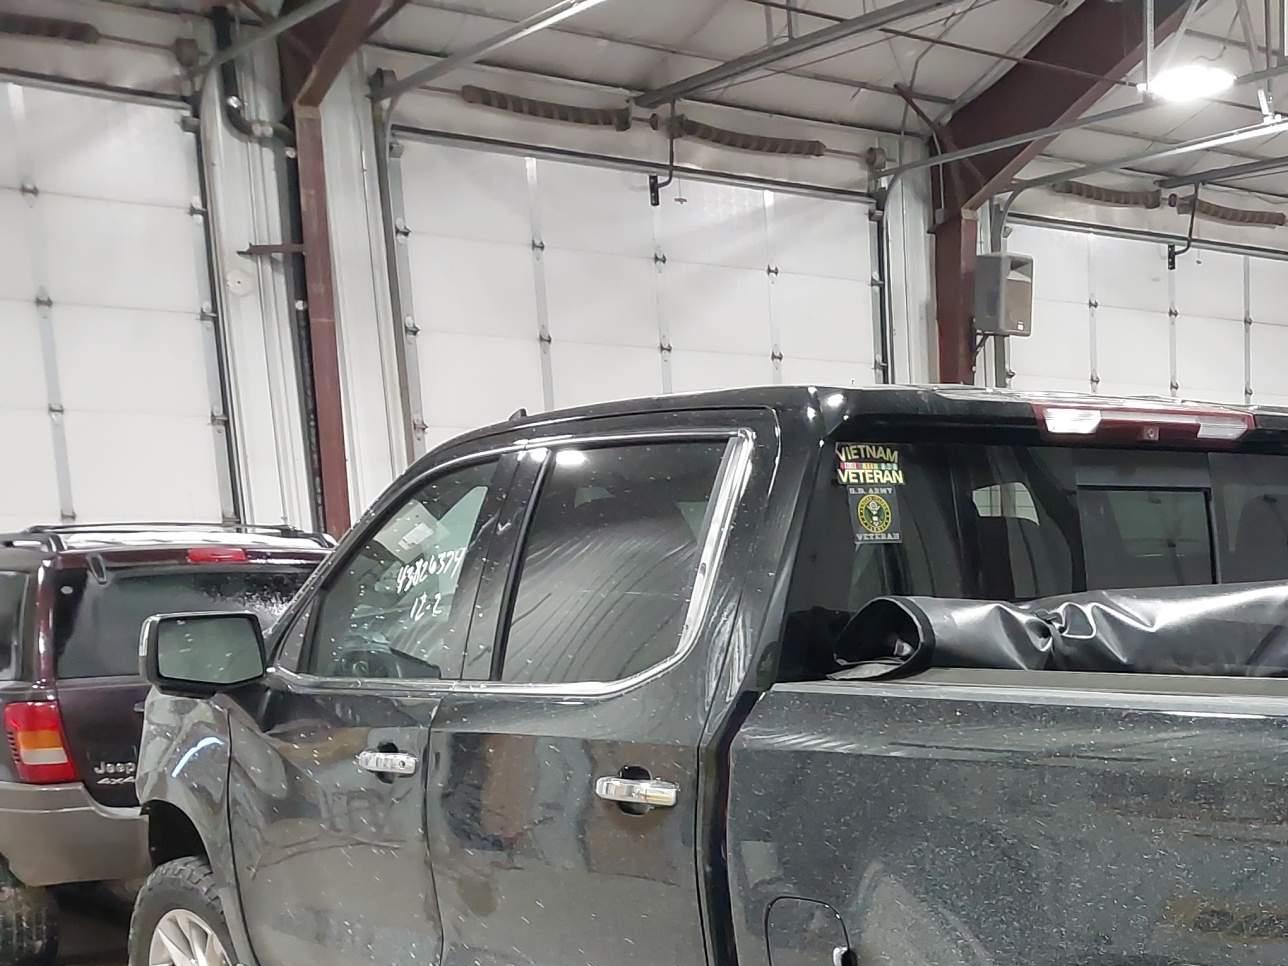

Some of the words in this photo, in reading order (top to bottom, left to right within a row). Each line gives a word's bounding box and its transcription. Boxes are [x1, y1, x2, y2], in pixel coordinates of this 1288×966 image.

[835, 444, 899, 463] VIETNAM
[837, 469, 904, 484] VETERAN
[855, 532, 900, 540] VETERAN
[396, 546, 468, 594] 43826374
[93, 761, 136, 774] Jeep
